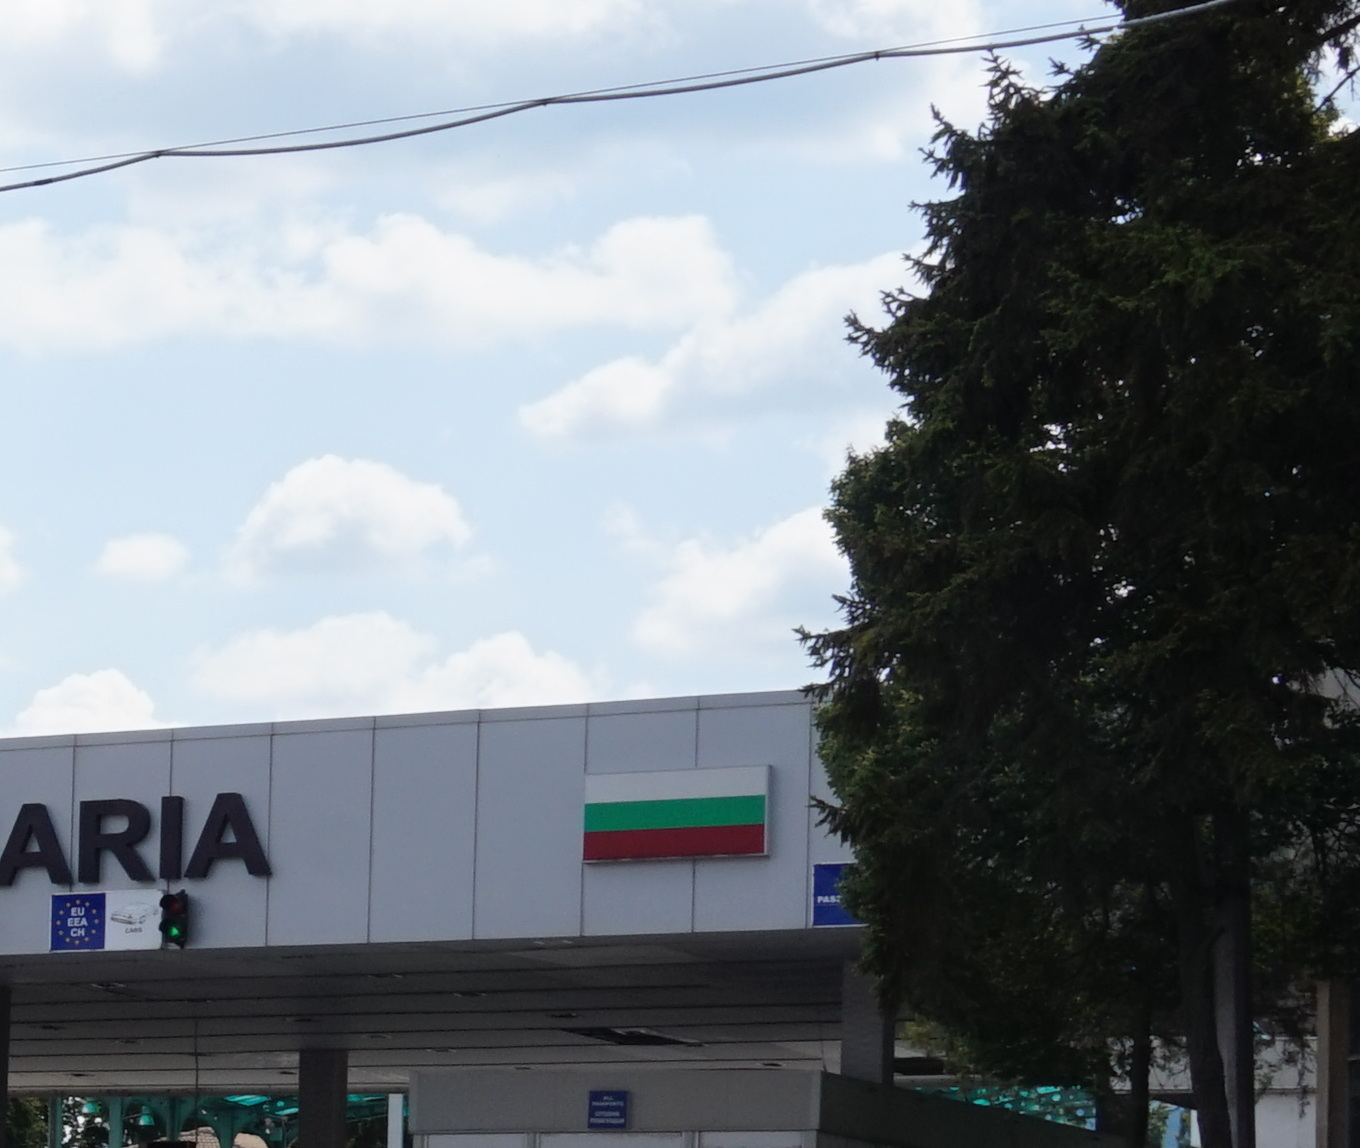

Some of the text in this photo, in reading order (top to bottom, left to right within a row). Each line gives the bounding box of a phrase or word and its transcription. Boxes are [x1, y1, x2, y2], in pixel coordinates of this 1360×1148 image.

[70, 907, 85, 917] EU
[67, 917, 88, 927] EEA
[70, 928, 85, 937] CH
